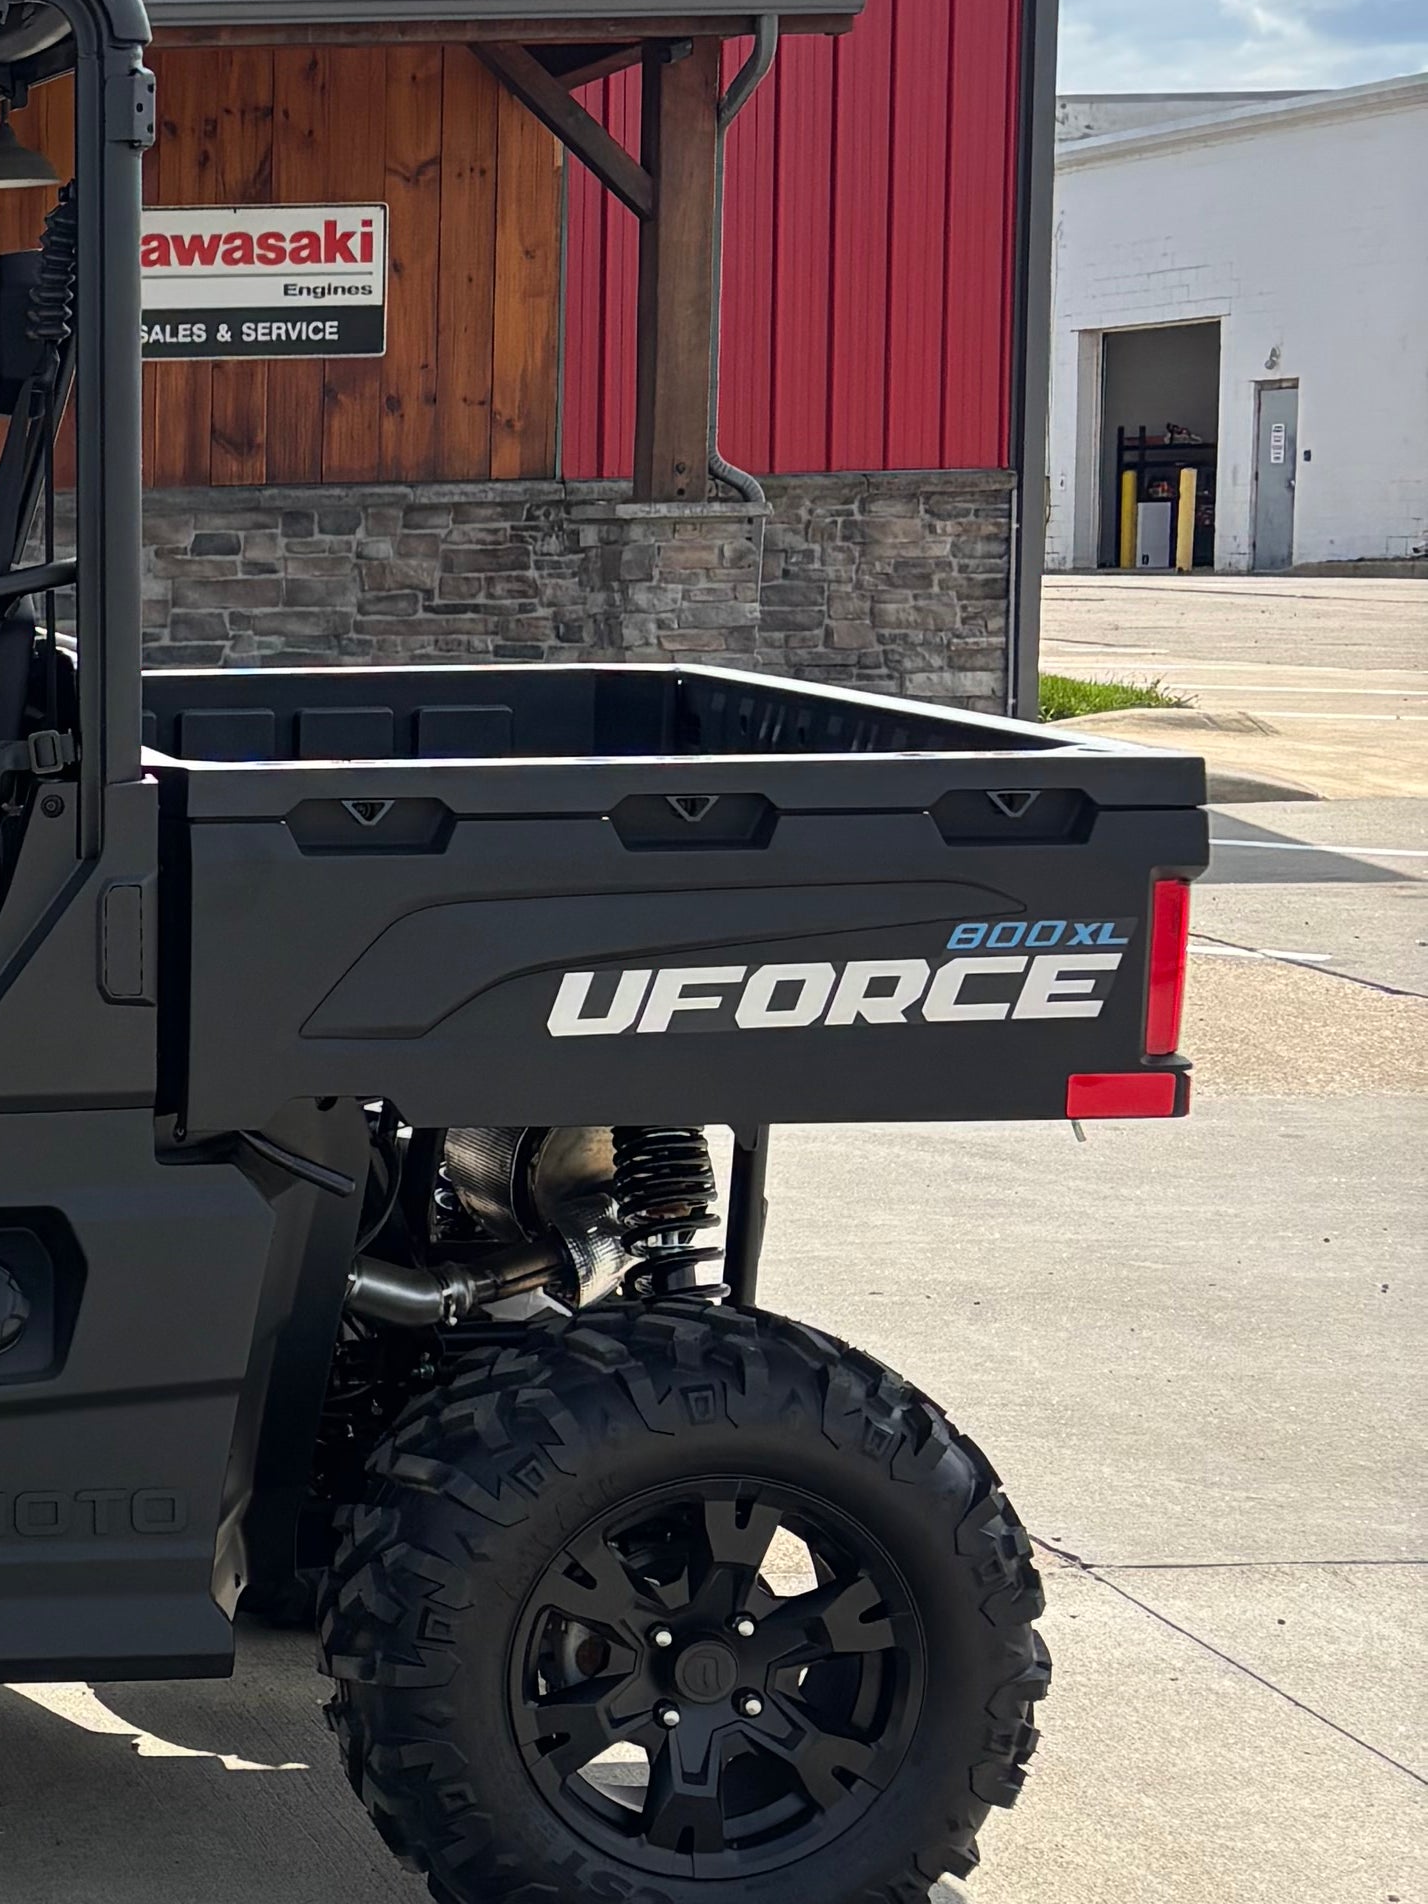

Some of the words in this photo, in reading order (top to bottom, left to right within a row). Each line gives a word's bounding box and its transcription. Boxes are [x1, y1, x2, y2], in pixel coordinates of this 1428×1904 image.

[140, 218, 374, 268] awasaki
[282, 282, 374, 300] Engines
[215, 322, 233, 343] &
[241, 320, 340, 342] SERVICE
[546, 952, 1123, 1037] UFORCE
